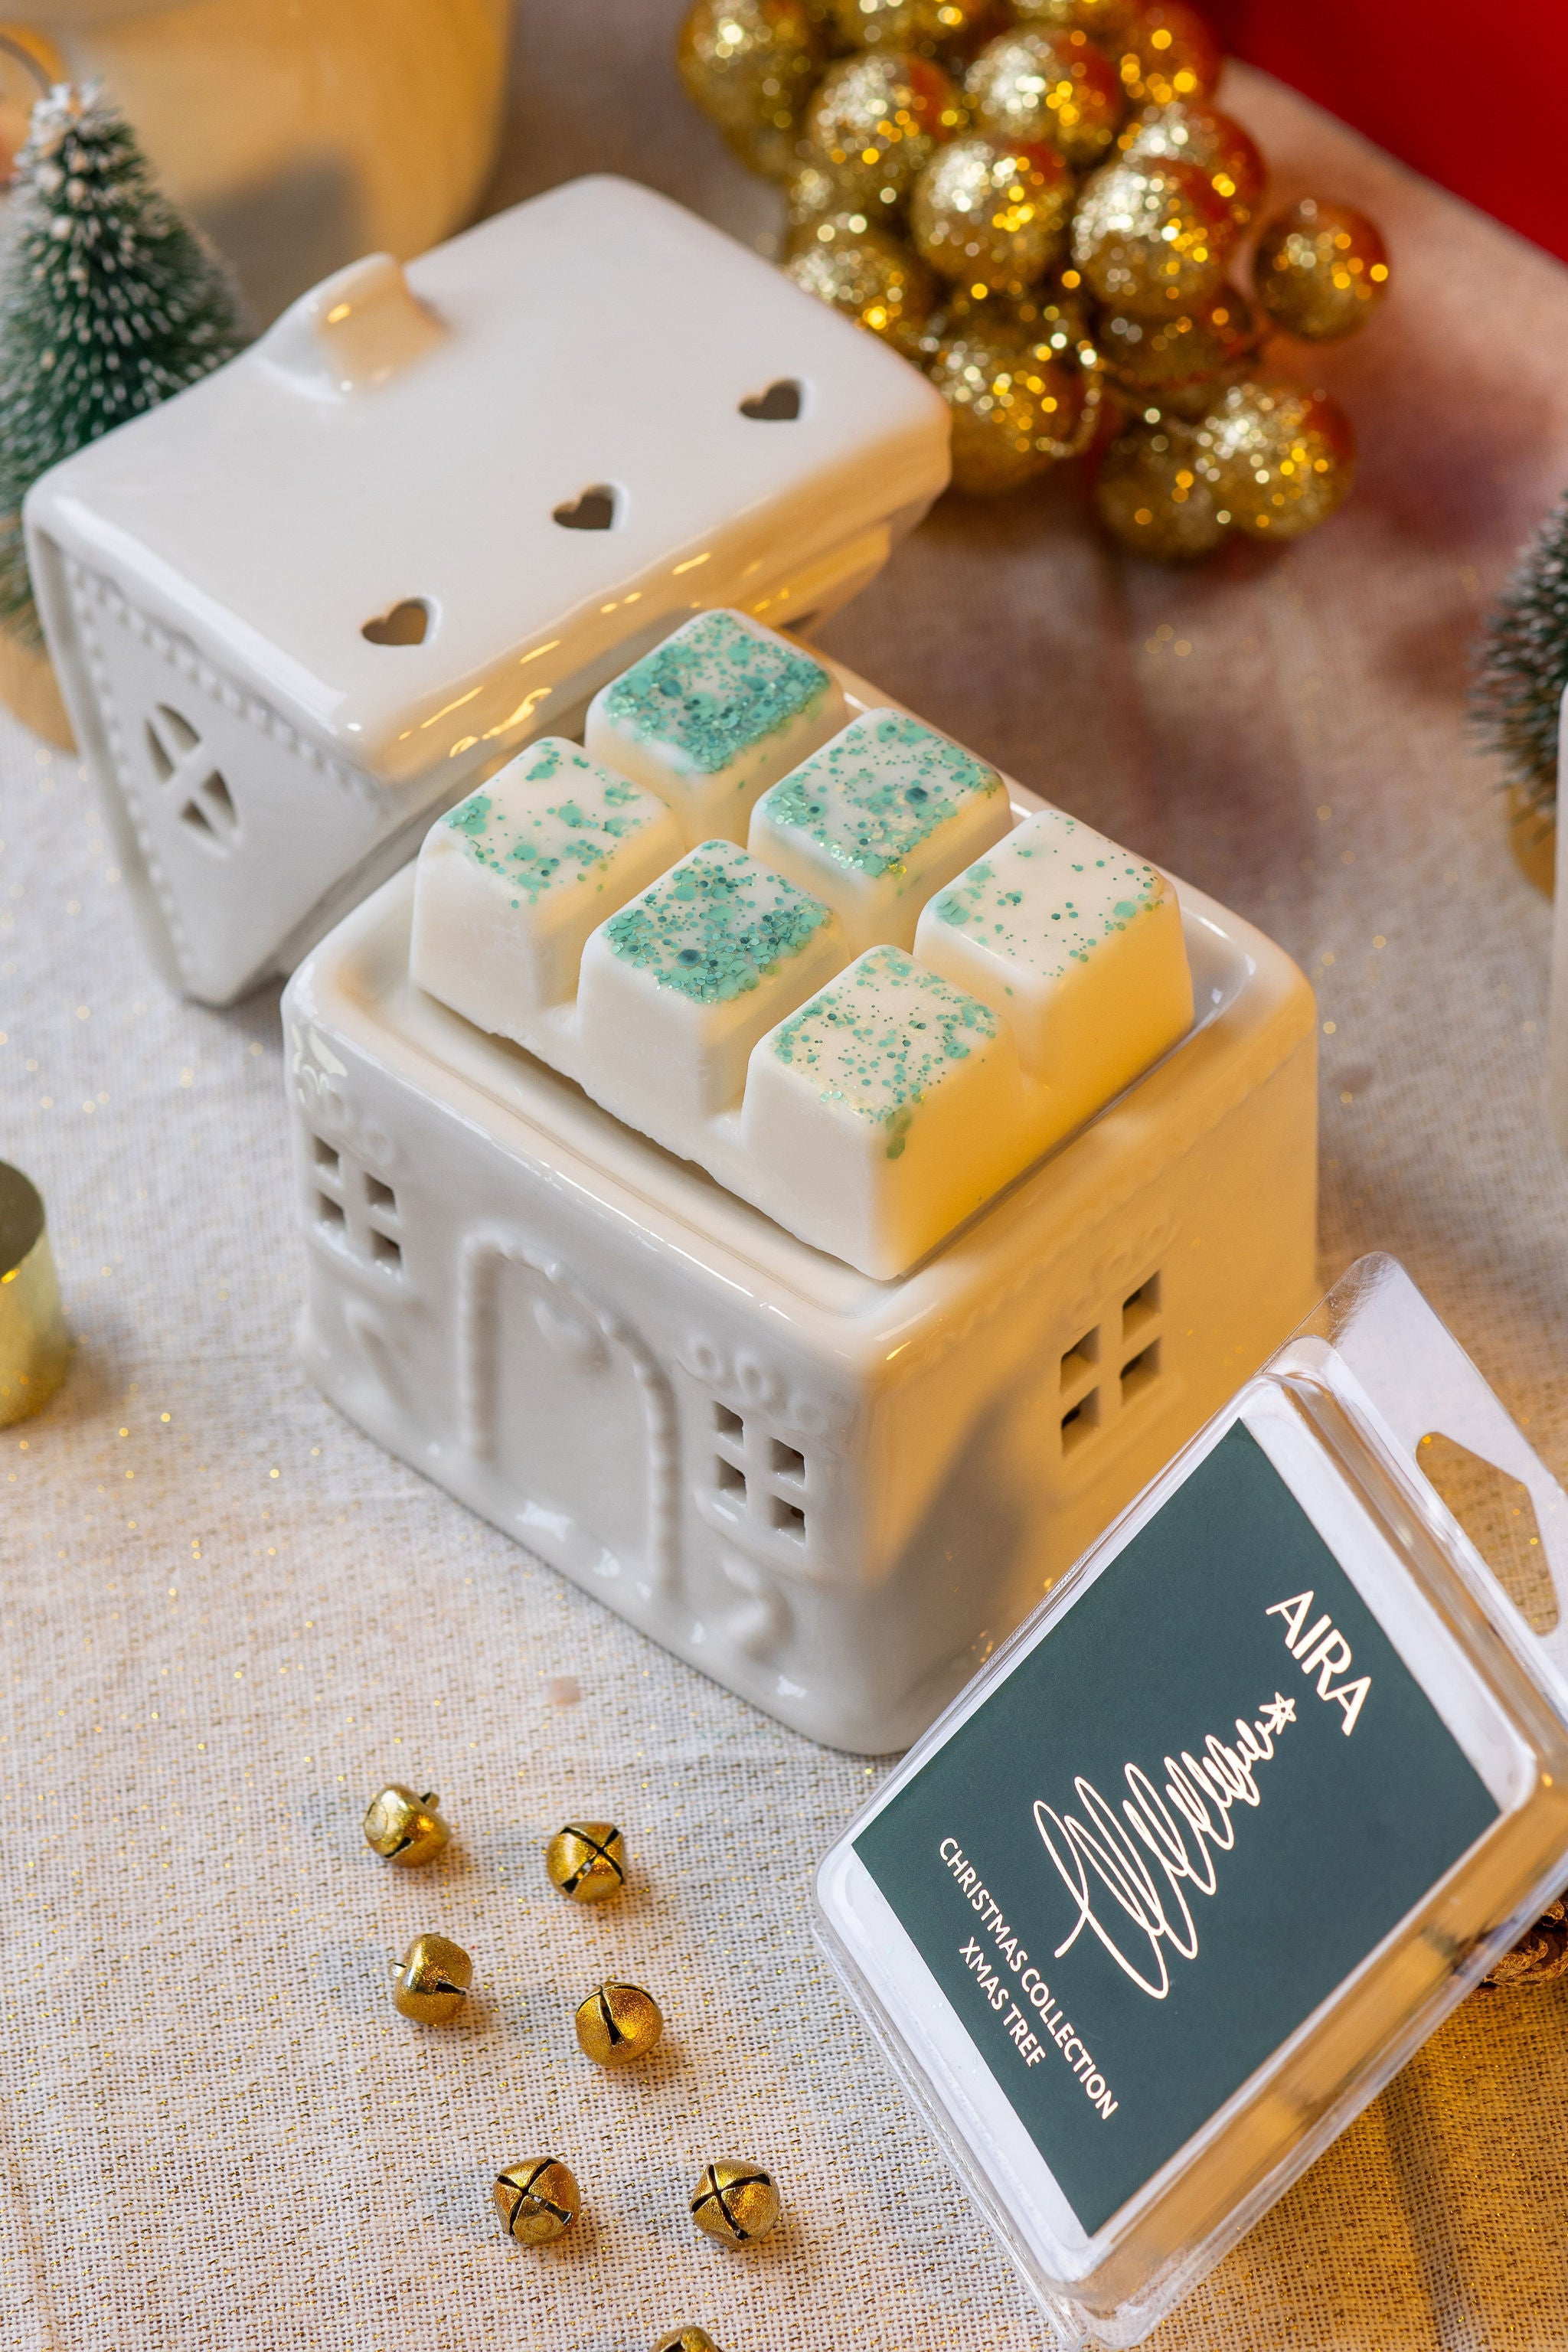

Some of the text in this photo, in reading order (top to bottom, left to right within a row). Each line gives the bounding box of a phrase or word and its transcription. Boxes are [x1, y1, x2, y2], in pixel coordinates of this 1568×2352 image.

[1265, 1589, 1372, 1736] AIRA
[939, 1838, 1119, 2120] CHRISTMAS COLLECTION
[959, 1936, 1046, 2068] XMAS TREE
